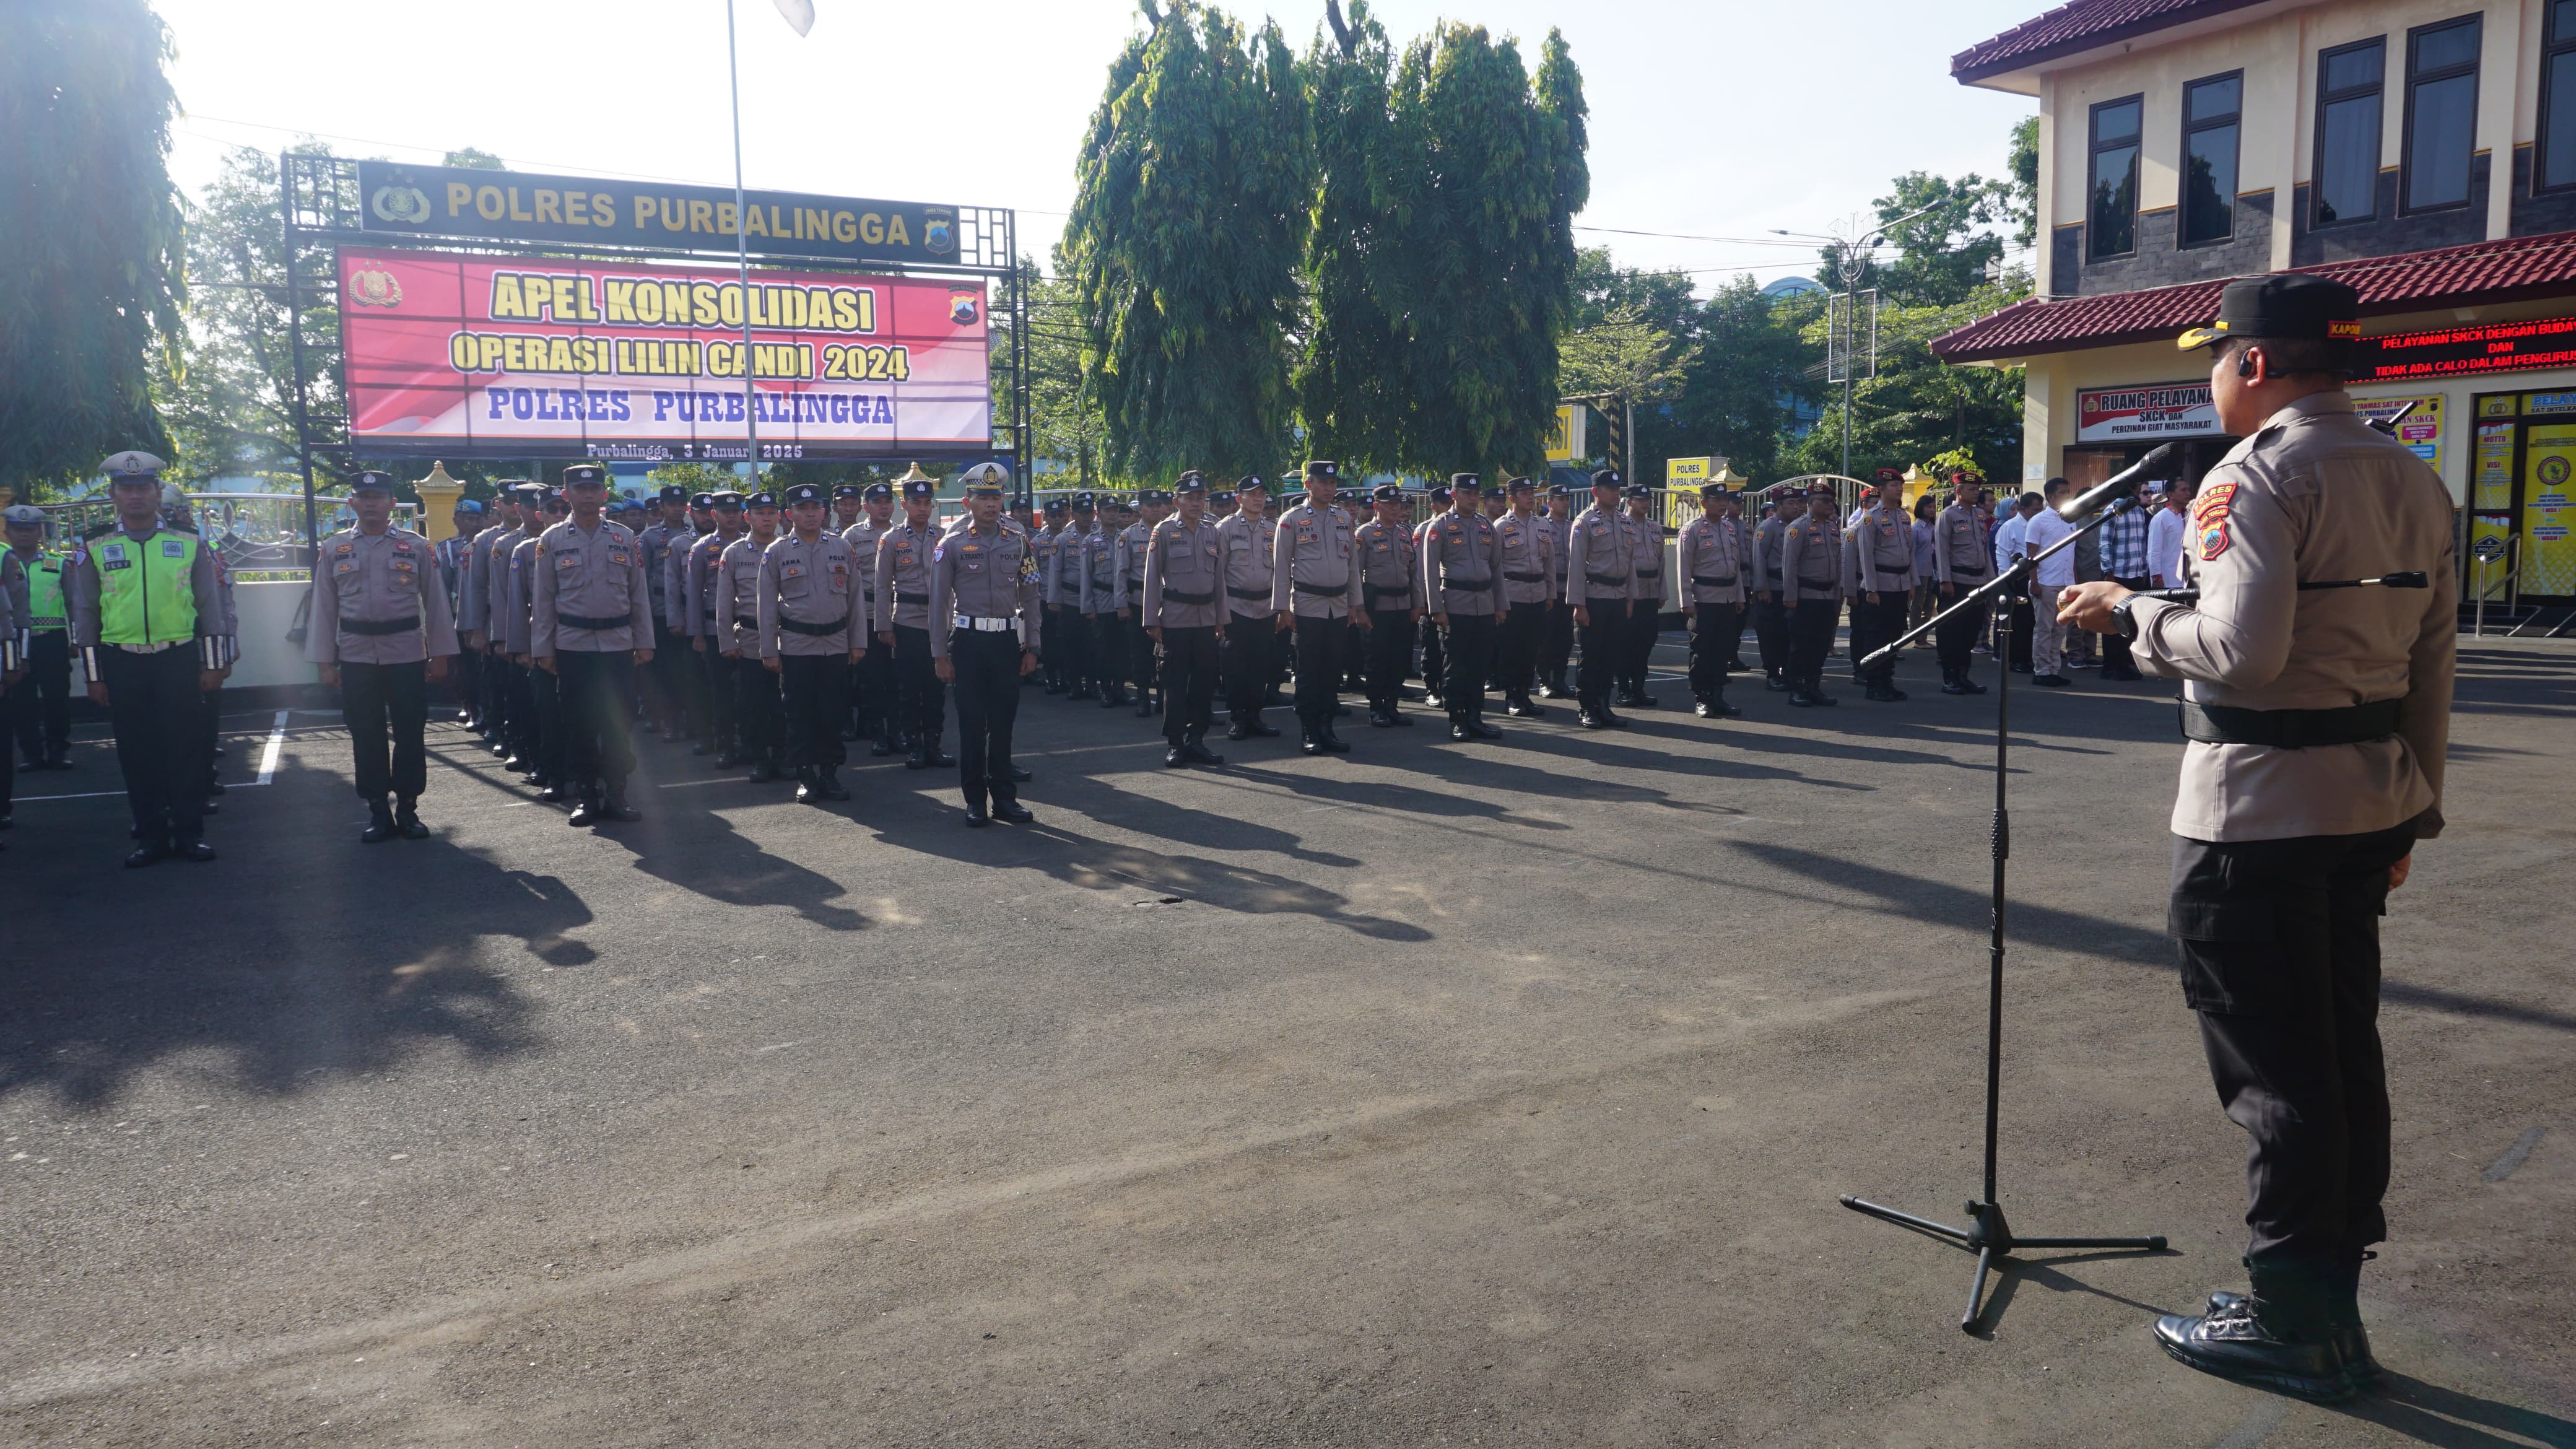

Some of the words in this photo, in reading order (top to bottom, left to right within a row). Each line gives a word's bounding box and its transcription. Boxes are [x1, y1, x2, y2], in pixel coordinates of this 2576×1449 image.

[446, 182, 617, 227] POLRES
[633, 195, 910, 246] PURBALINGGA
[492, 274, 600, 322] APEL
[603, 279, 873, 331] KONSOLIDASI
[2382, 334, 2450, 349] PELAYANAN
[2451, 329, 2484, 343] SKCK
[2486, 324, 2536, 340] DENGAN
[2487, 342, 2514, 354] DAN
[451, 334, 611, 374] OPERASI
[616, 339, 702, 375] LILIN
[707, 341, 814, 379] CANDI
[823, 346, 910, 381] 2024
[2375, 364, 2407, 377] TIDAK
[2408, 362, 2433, 374] ADA
[2435, 359, 2468, 372] CALO
[2469, 356, 2512, 370] DALAM
[488, 388, 631, 422] POLRES
[653, 391, 894, 425] PURBALINGGA
[2100, 392, 2146, 411] RUANG
[2139, 410, 2165, 422] SKCK
[2168, 412, 2183, 421] DAN
[2415, 414, 2437, 423] SKCK
[2112, 424, 2146, 433] PERIZINAN
[2147, 423, 2163, 432] GIAT
[2164, 420, 2213, 431] MASYARAKAT
[586, 443, 674, 461] Purbalingga,
[684, 444, 694, 458] 3
[702, 444, 751, 458] Januar
[763, 444, 803, 458] 2025
[1676, 464, 1700, 474] POLRES
[1669, 477, 1706, 486] PURBALINGGA
[608, 544, 630, 552] POLRI
[781, 559, 801, 567] ARMA
